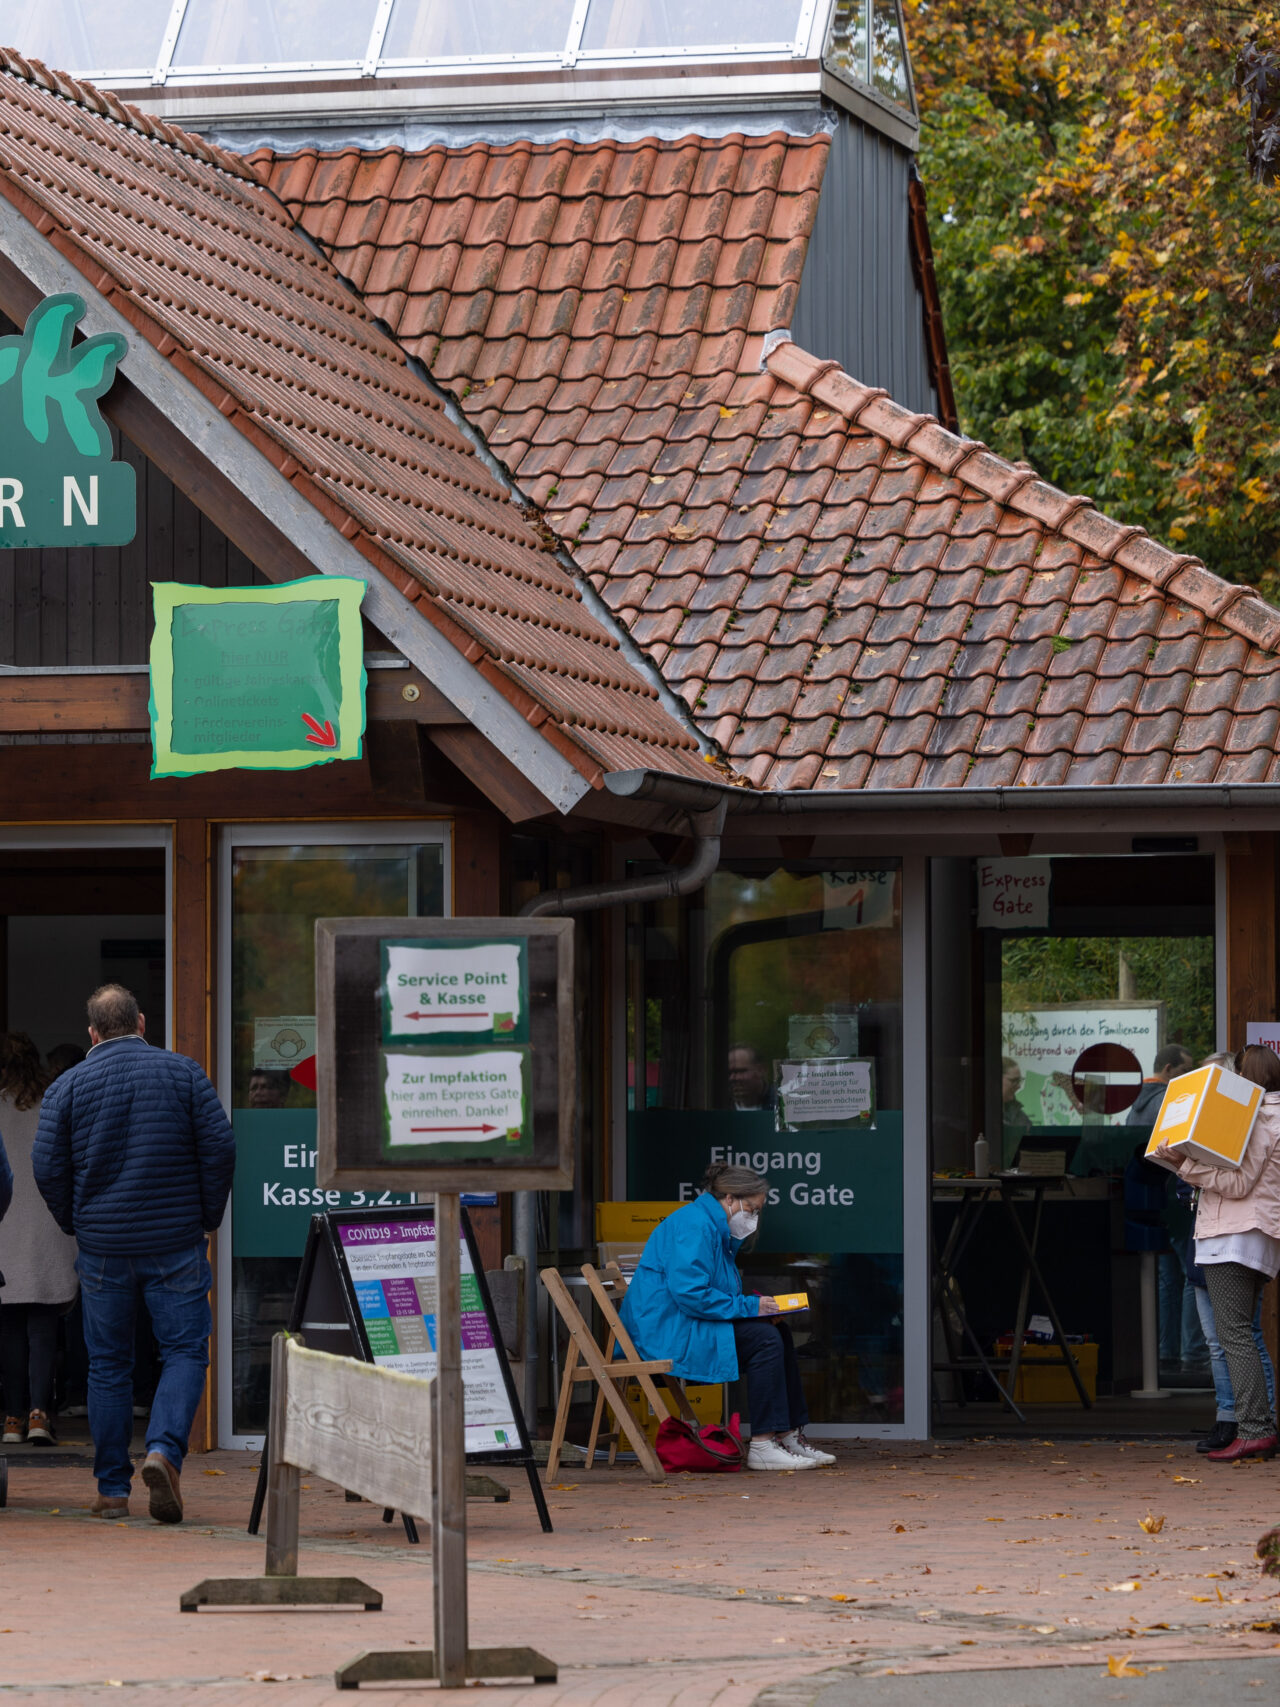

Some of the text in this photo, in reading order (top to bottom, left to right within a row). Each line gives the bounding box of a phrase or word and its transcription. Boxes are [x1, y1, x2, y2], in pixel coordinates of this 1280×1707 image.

[180, 607, 333, 643] Express Gate
[220, 650, 289, 665] hier NUR
[194, 695, 280, 707] Onlinetickets
[194, 731, 262, 745] mitglieder
[981, 866, 1046, 892] Express
[847, 888, 864, 925] 1
[992, 892, 1033, 917] Gate
[397, 972, 508, 987] Service Point
[419, 992, 486, 1005] & Kasse
[1008, 1019, 1150, 1041] Rundgang durch den Familienzoo
[402, 1071, 508, 1086] Zur Impfaktion
[391, 1088, 519, 1104] hier am Express Gate
[402, 1105, 509, 1119] einreihen. Danke!
[710, 1146, 821, 1176] Eingang
[263, 1183, 341, 1206] Kasse
[789, 1182, 855, 1206] Gate
[347, 1226, 391, 1241] COVID19
[400, 1224, 436, 1239] Impfsta
